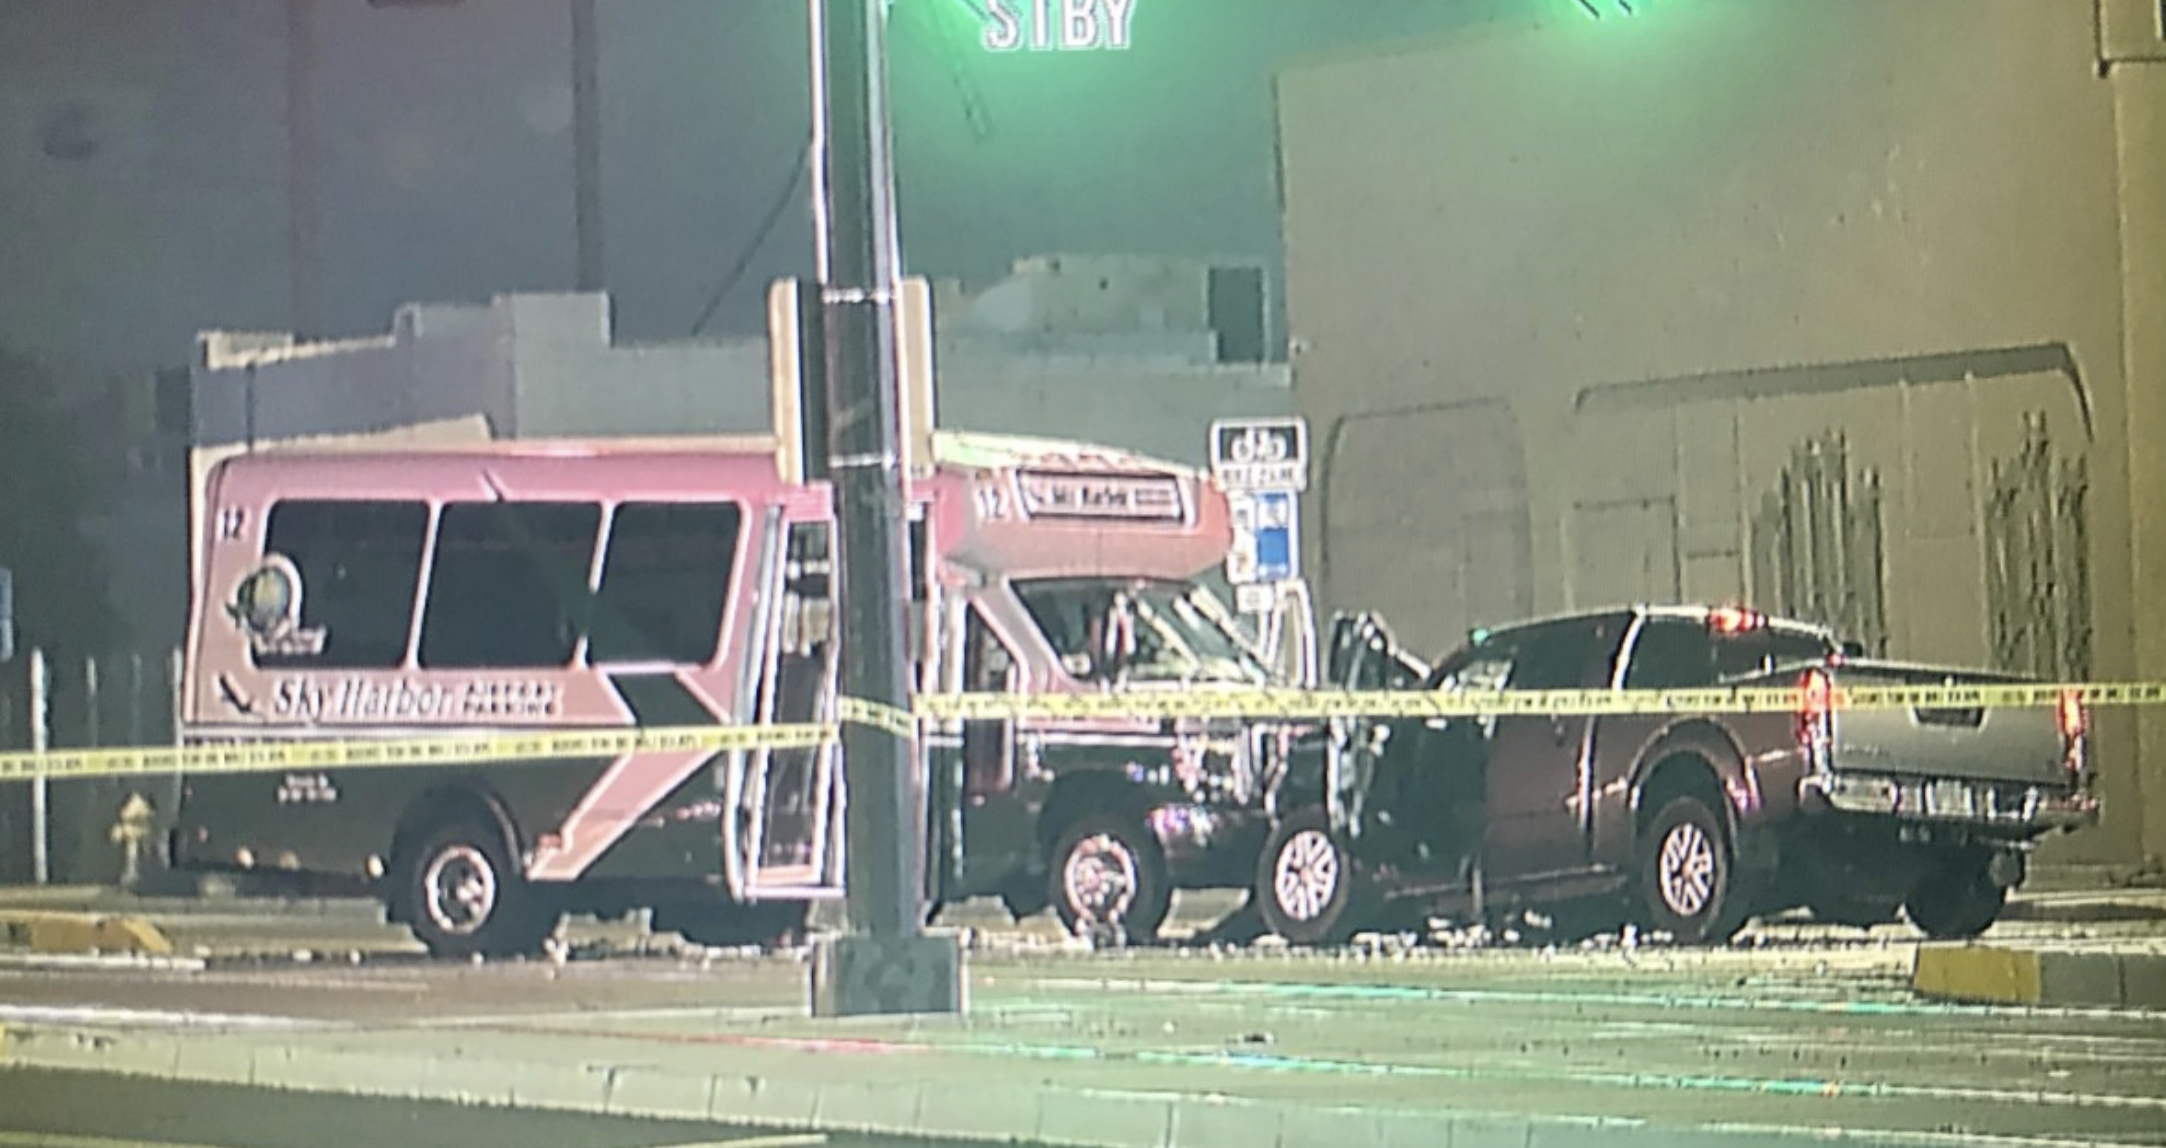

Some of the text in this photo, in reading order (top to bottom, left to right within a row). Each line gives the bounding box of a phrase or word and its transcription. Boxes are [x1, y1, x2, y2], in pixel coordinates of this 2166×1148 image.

[982, 0, 1138, 50] STBY
[221, 508, 246, 541] 12
[274, 676, 453, 722] Sky Harbor
